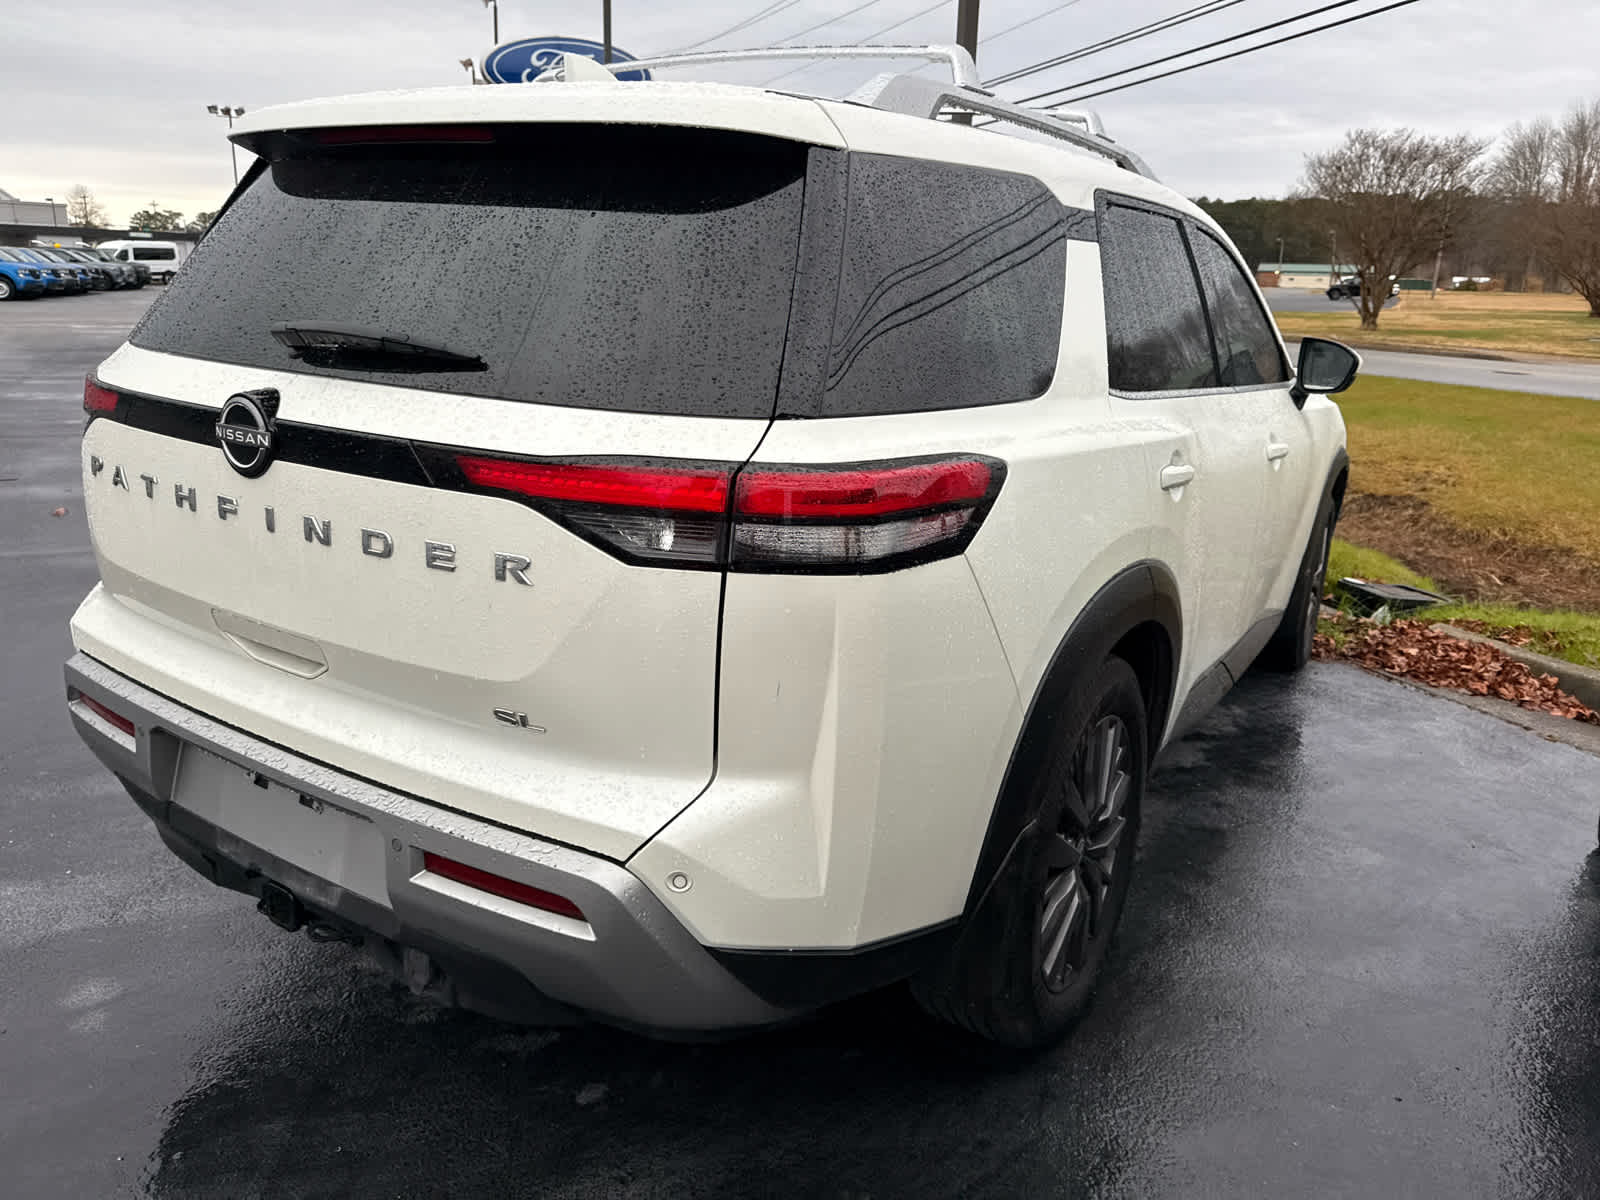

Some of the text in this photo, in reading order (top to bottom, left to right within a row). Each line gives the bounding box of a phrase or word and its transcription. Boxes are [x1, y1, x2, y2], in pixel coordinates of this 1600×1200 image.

[215, 425, 269, 447] NISSAN
[91, 455, 534, 586] PATHFINDER
[493, 707, 547, 733] SL
